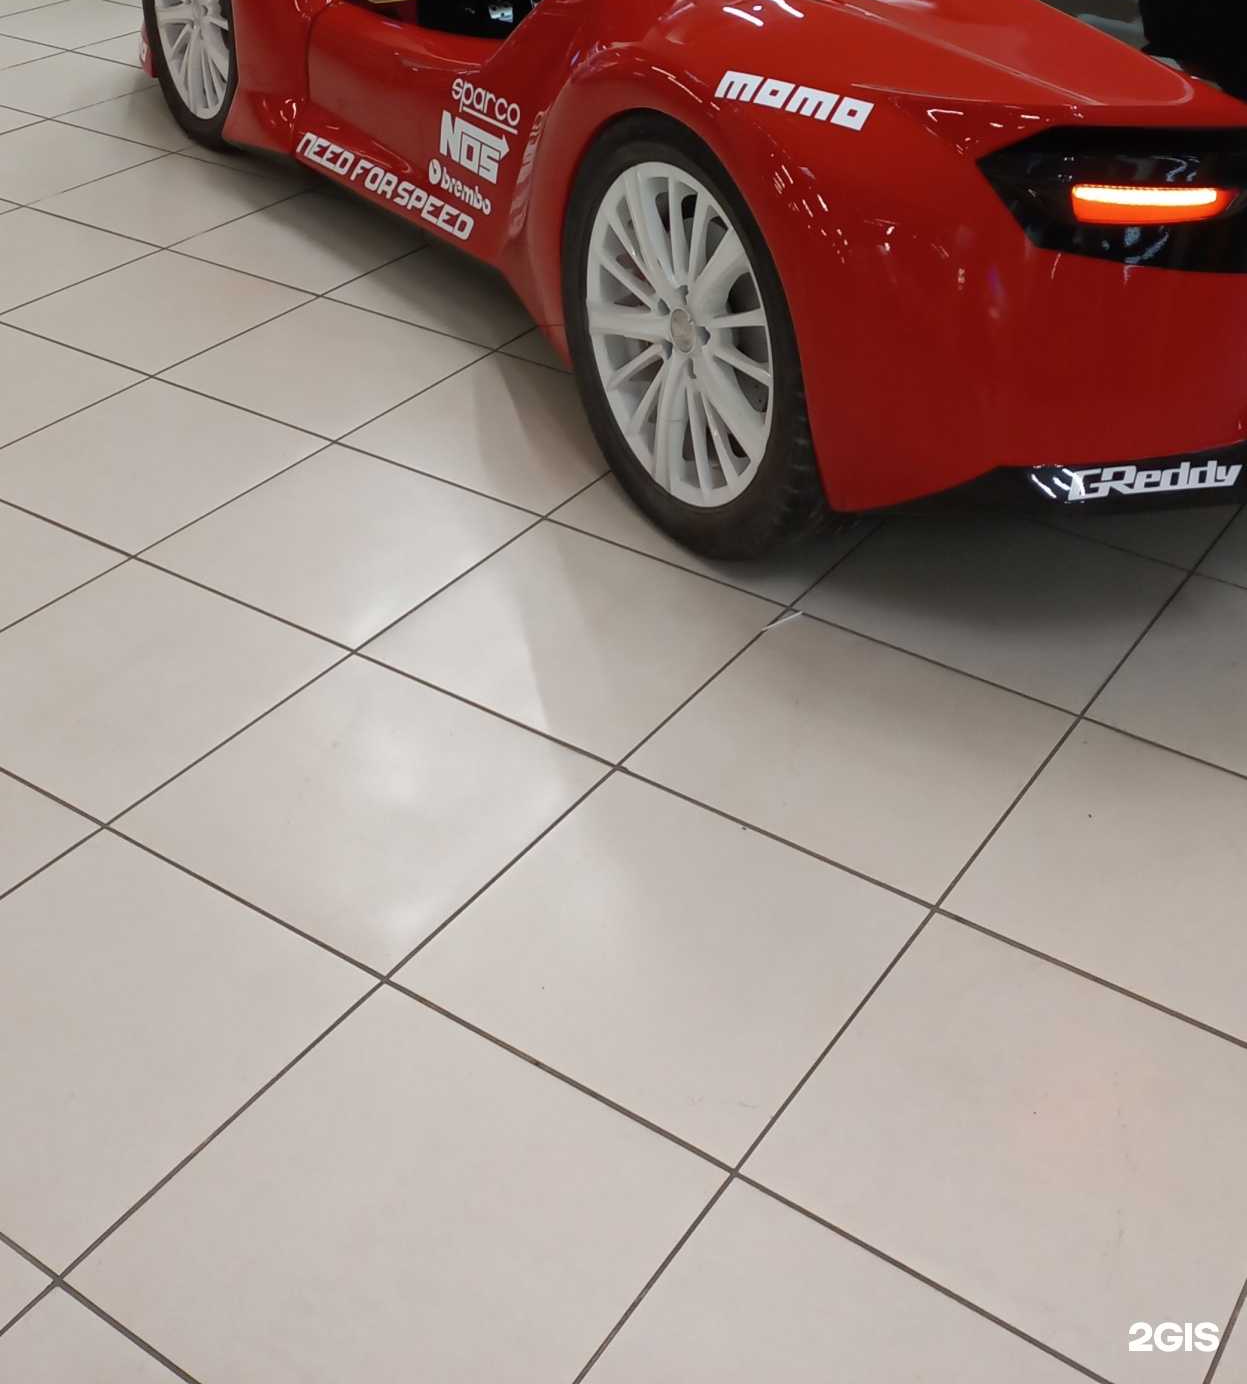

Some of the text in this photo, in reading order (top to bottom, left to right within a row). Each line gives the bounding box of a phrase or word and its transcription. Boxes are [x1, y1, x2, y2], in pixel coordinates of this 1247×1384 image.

[452, 78, 521, 127] sparco
[440, 110, 503, 185] NOS
[296, 132, 475, 241] NEED FOR SPEED
[440, 172, 492, 215] brembo
